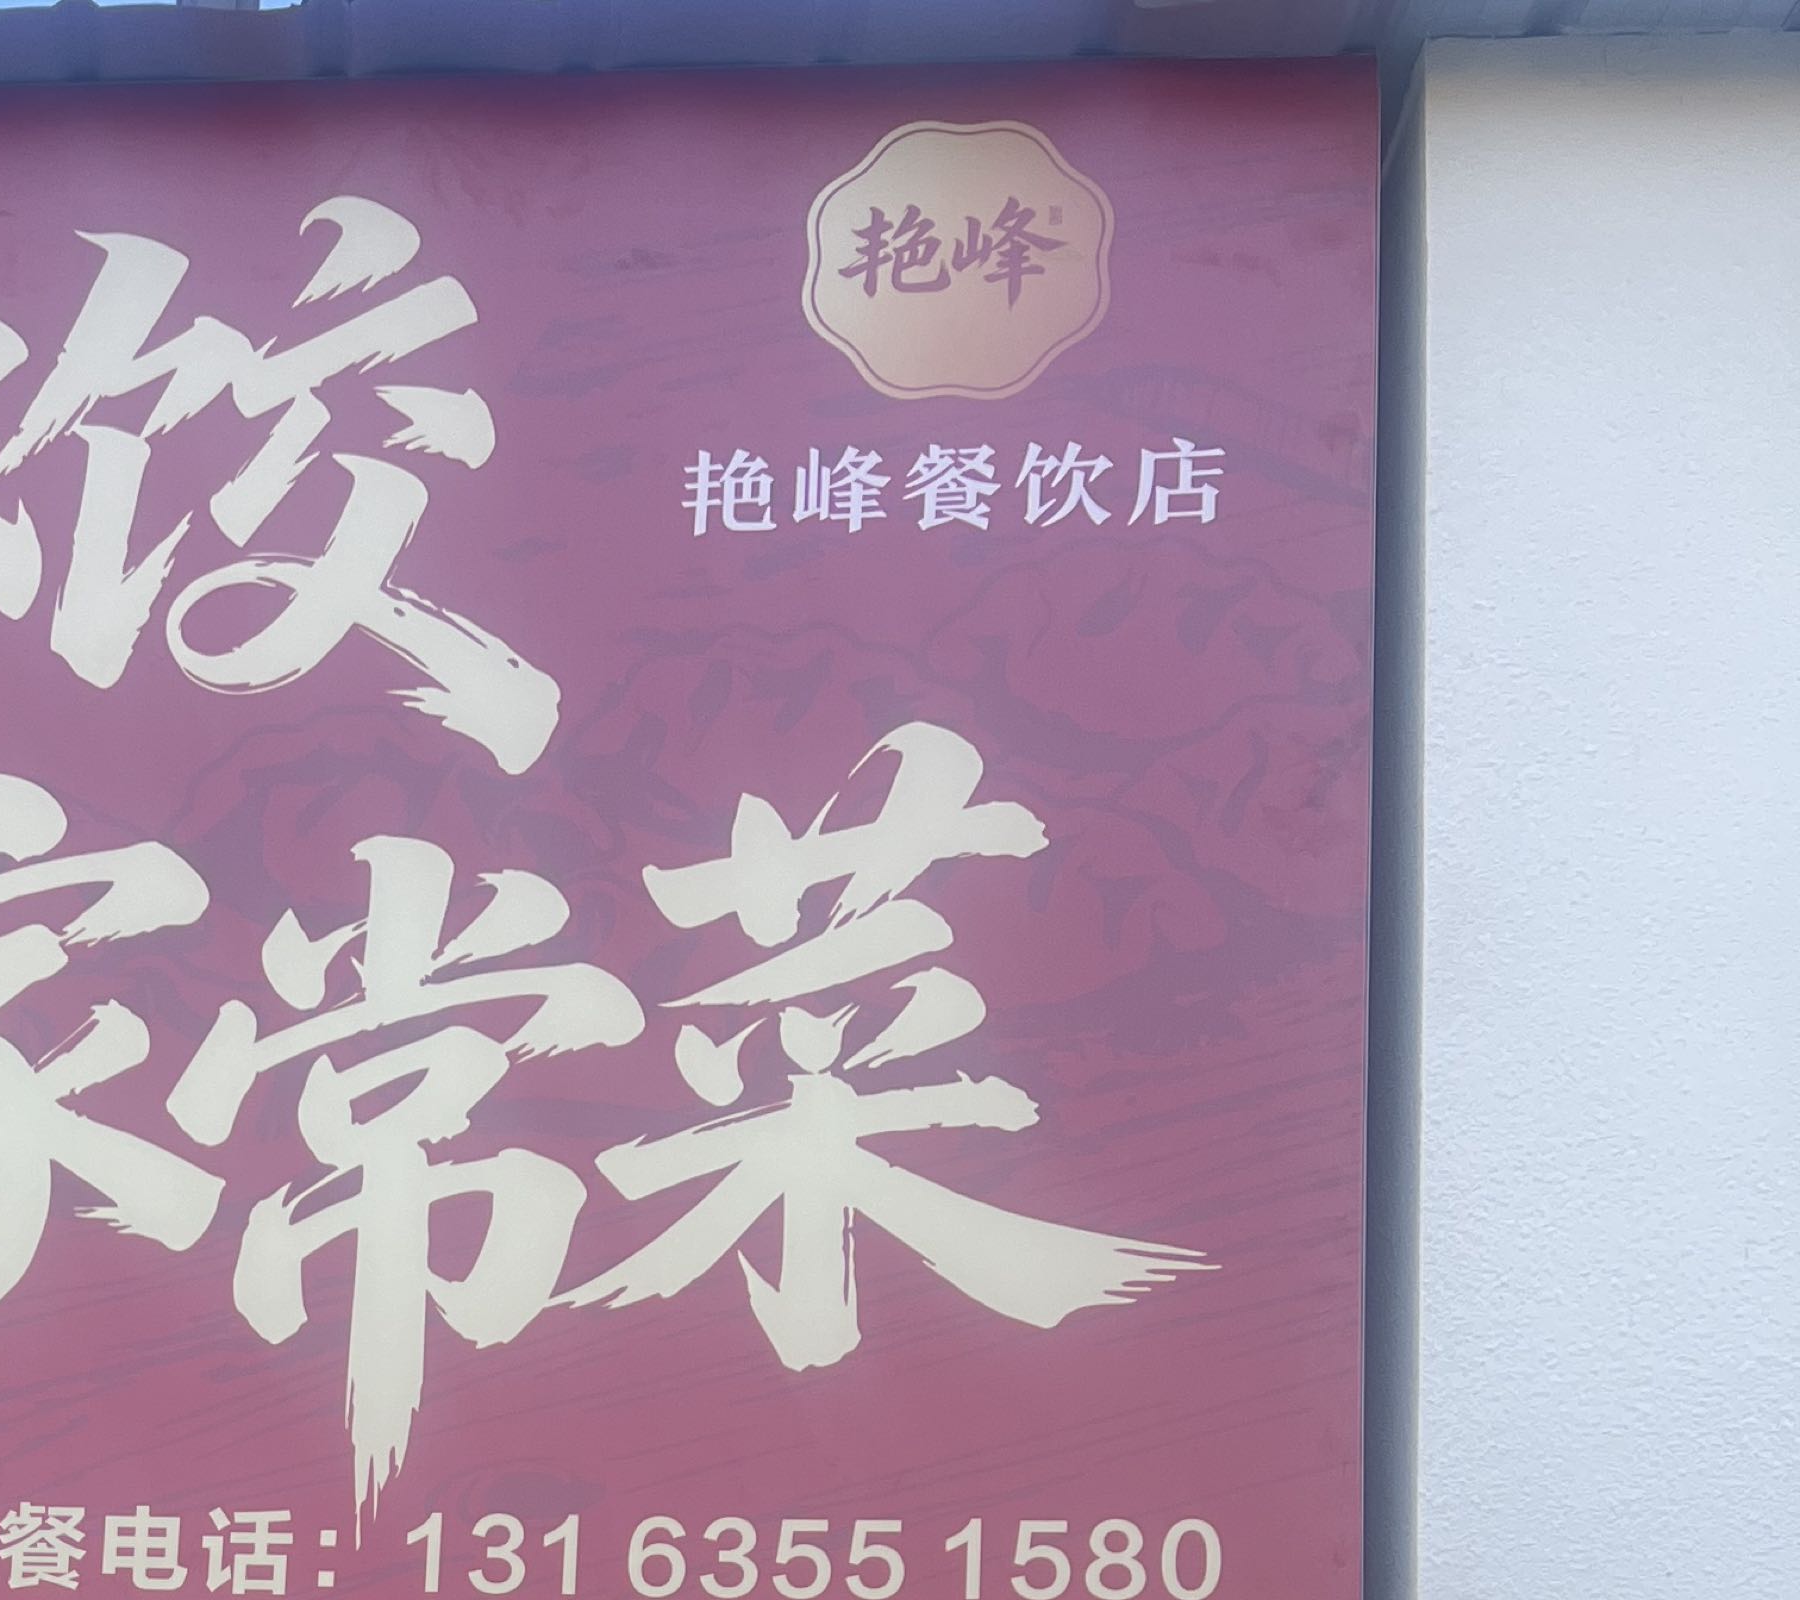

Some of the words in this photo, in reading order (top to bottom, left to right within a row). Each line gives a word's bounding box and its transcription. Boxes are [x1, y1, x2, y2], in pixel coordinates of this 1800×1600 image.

[837, 195, 1069, 310] 艳峰
[681, 437, 1227, 537] 艳峰餐饮店
[403, 1512, 579, 1597] 131
[624, 1514, 907, 1600] 6355
